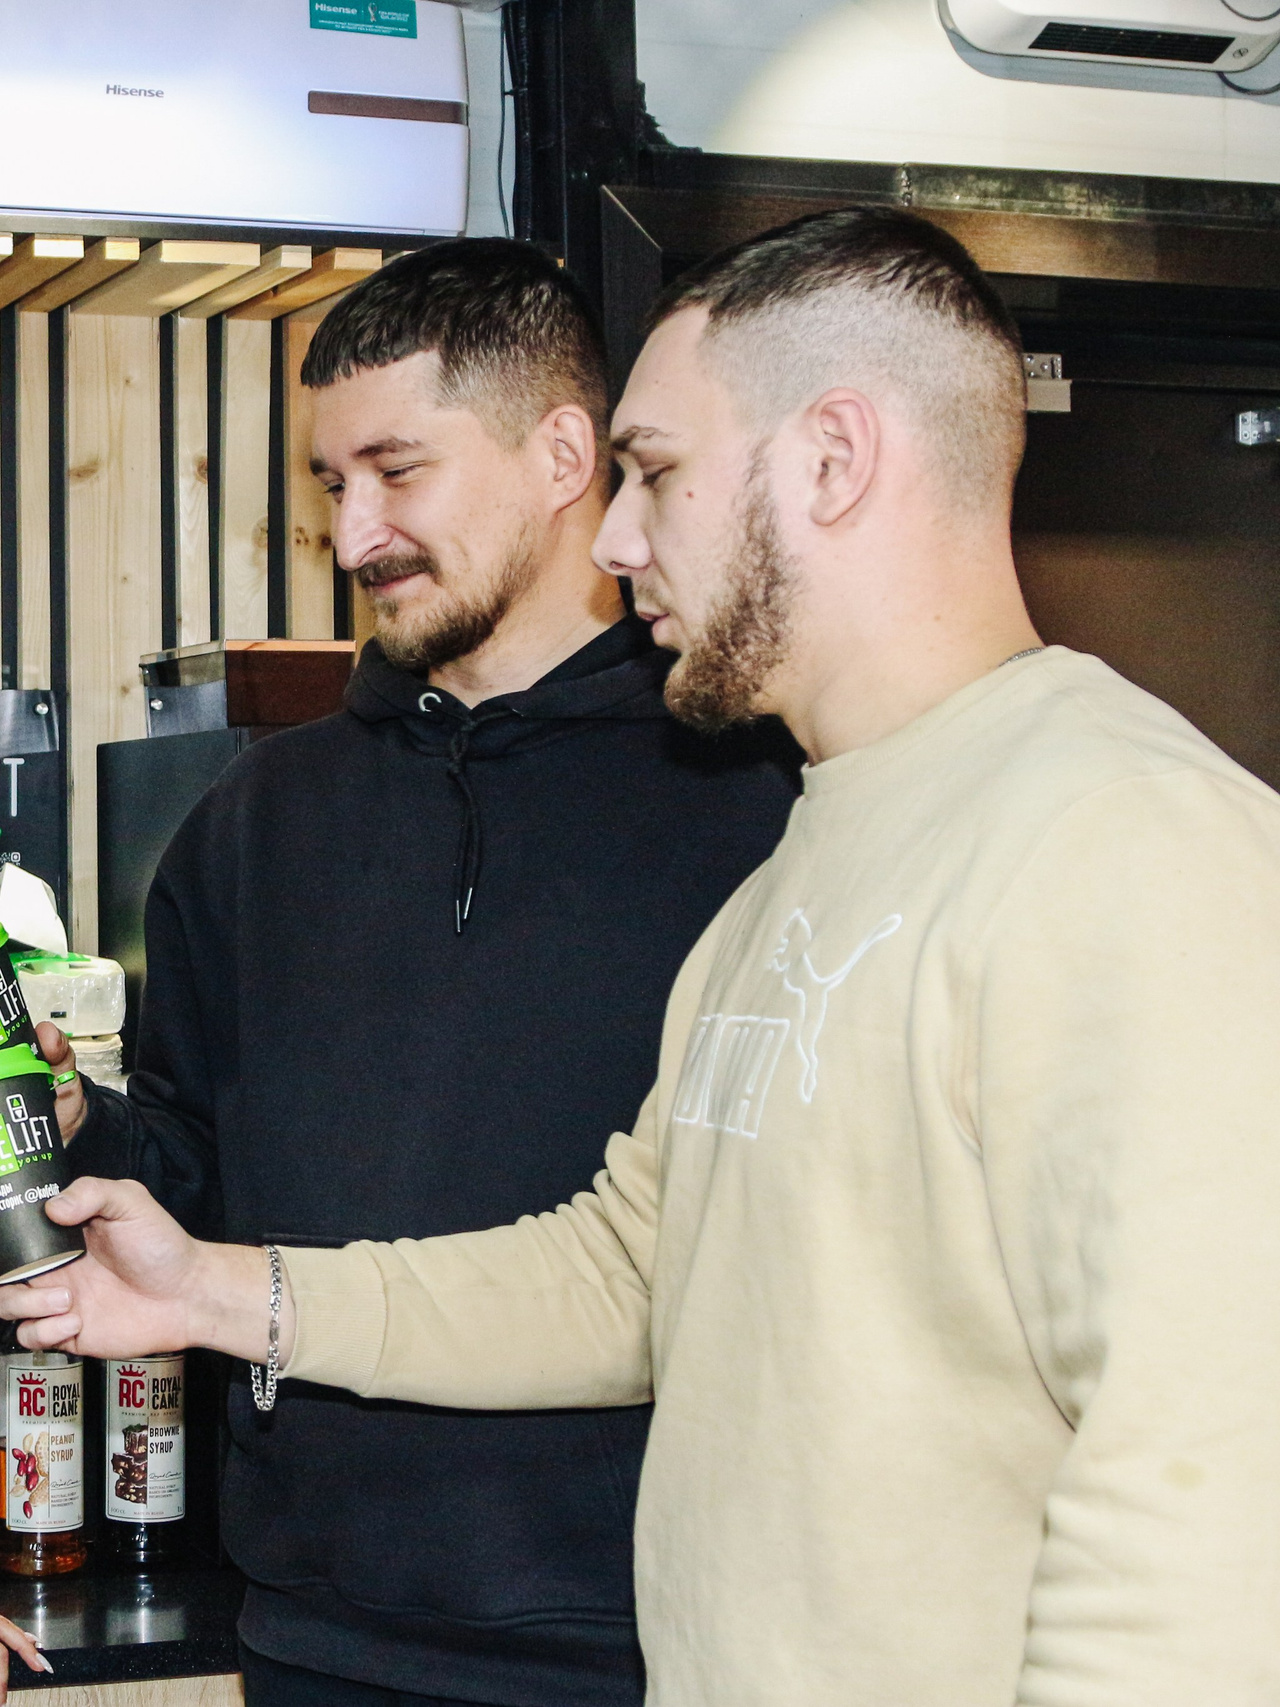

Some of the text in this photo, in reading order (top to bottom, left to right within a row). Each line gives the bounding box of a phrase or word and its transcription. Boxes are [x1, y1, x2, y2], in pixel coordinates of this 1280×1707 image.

[314, 3, 358, 15] Hisense
[106, 84, 165, 98] Hisense
[6, 1022, 21, 1037] you
[18, 1156, 38, 1168] you
[41, 1152, 53, 1162] up
[118, 1376, 182, 1408] RC ROYAL
[19, 1383, 80, 1417] RC ROYAL
[152, 1391, 179, 1410] CANE
[52, 1399, 78, 1418] CANE
[149, 1425, 180, 1438] BROWNIE
[51, 1433, 75, 1446] PEANUT
[149, 1441, 174, 1454] SYRUP
[51, 1449, 74, 1462] SYRUP
